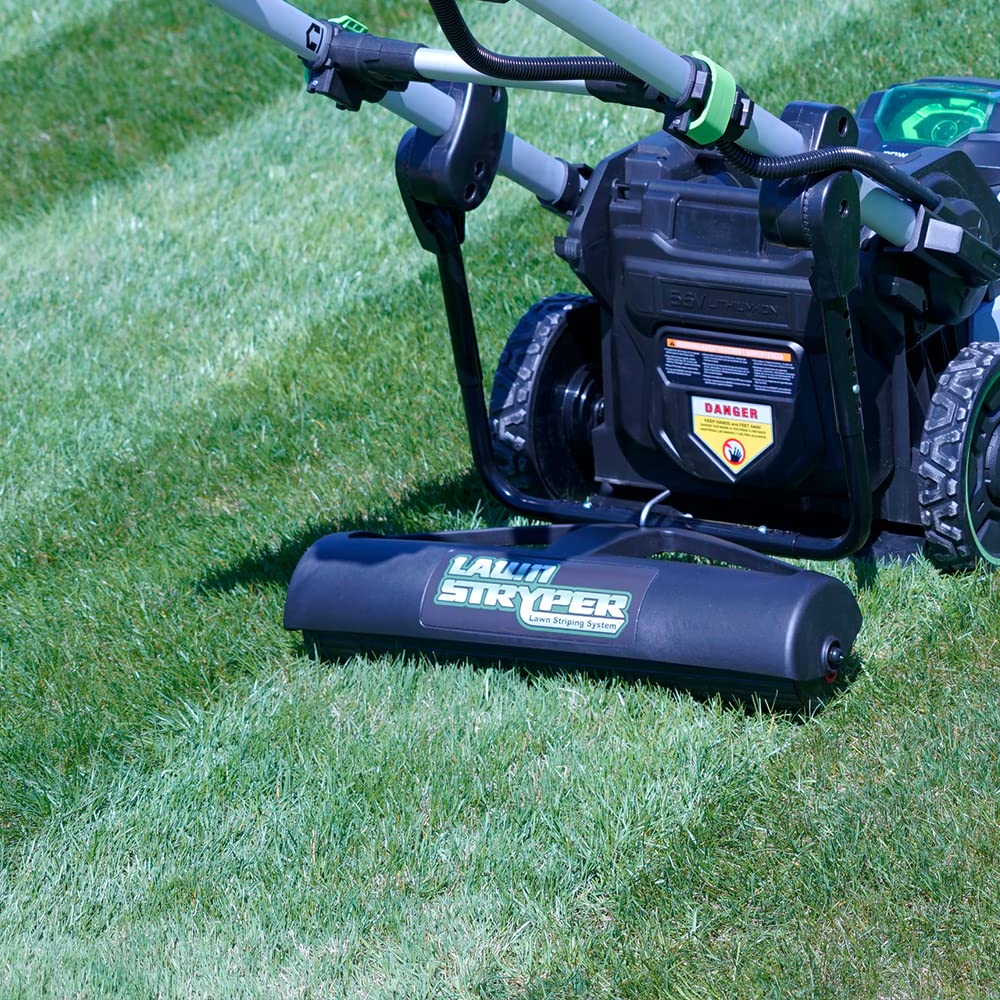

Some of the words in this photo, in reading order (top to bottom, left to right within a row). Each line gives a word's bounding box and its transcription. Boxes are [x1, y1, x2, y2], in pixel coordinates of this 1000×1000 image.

[704, 402, 758, 419] DANGER
[437, 579, 629, 618] STRYPER
[529, 615, 551, 624] Lawn
[552, 617, 585, 629] Striping
[586, 620, 617, 631] System
